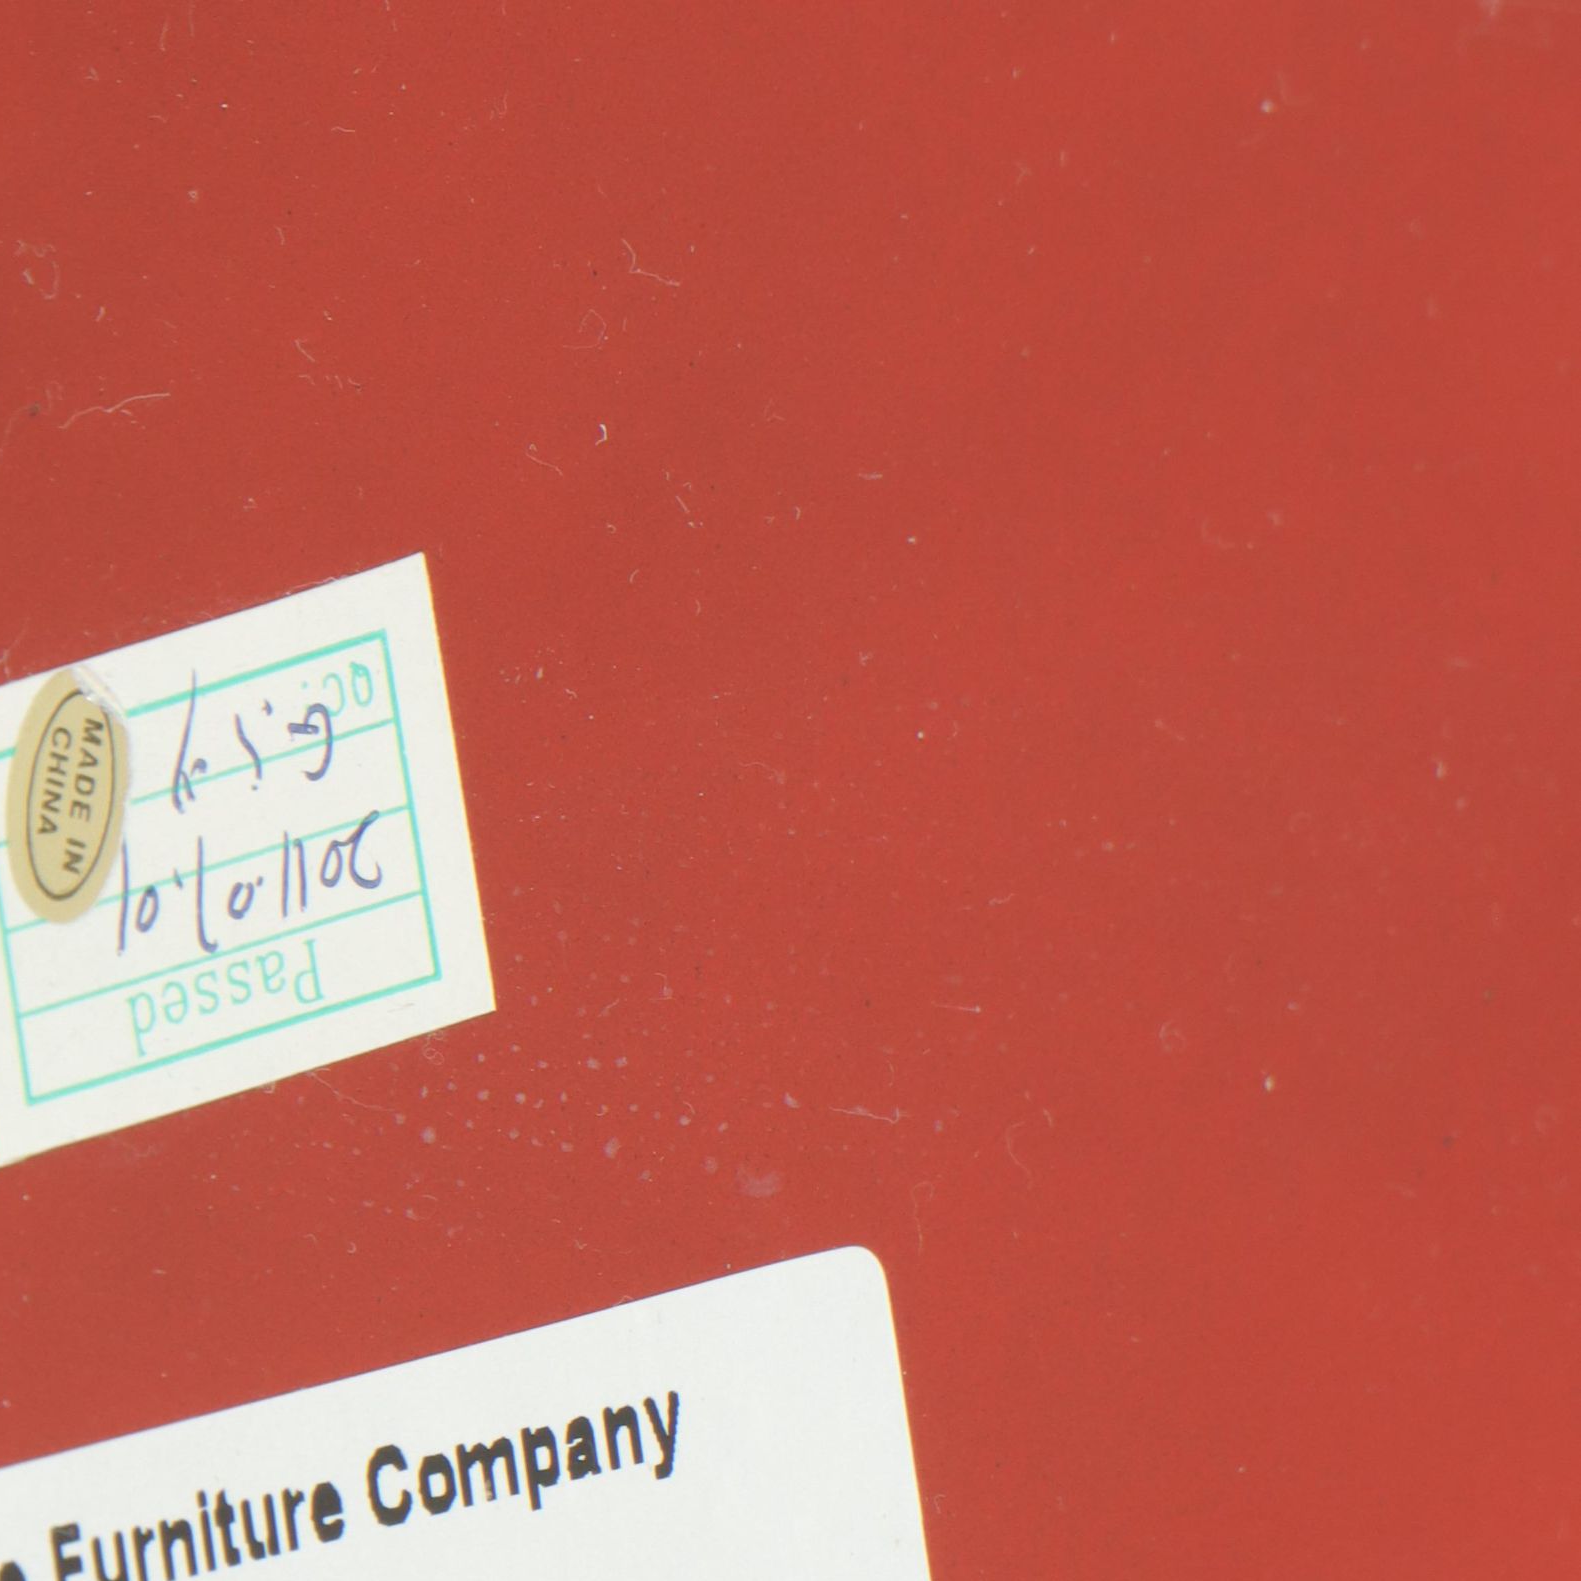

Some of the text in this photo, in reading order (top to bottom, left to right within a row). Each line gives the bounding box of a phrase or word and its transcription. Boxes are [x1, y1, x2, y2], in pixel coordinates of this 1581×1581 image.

[37, 727, 72, 837] CHINA
[62, 718, 105, 875] MADE IN
[127, 939, 326, 1058] Passed
[368, 1392, 679, 1526] Company
